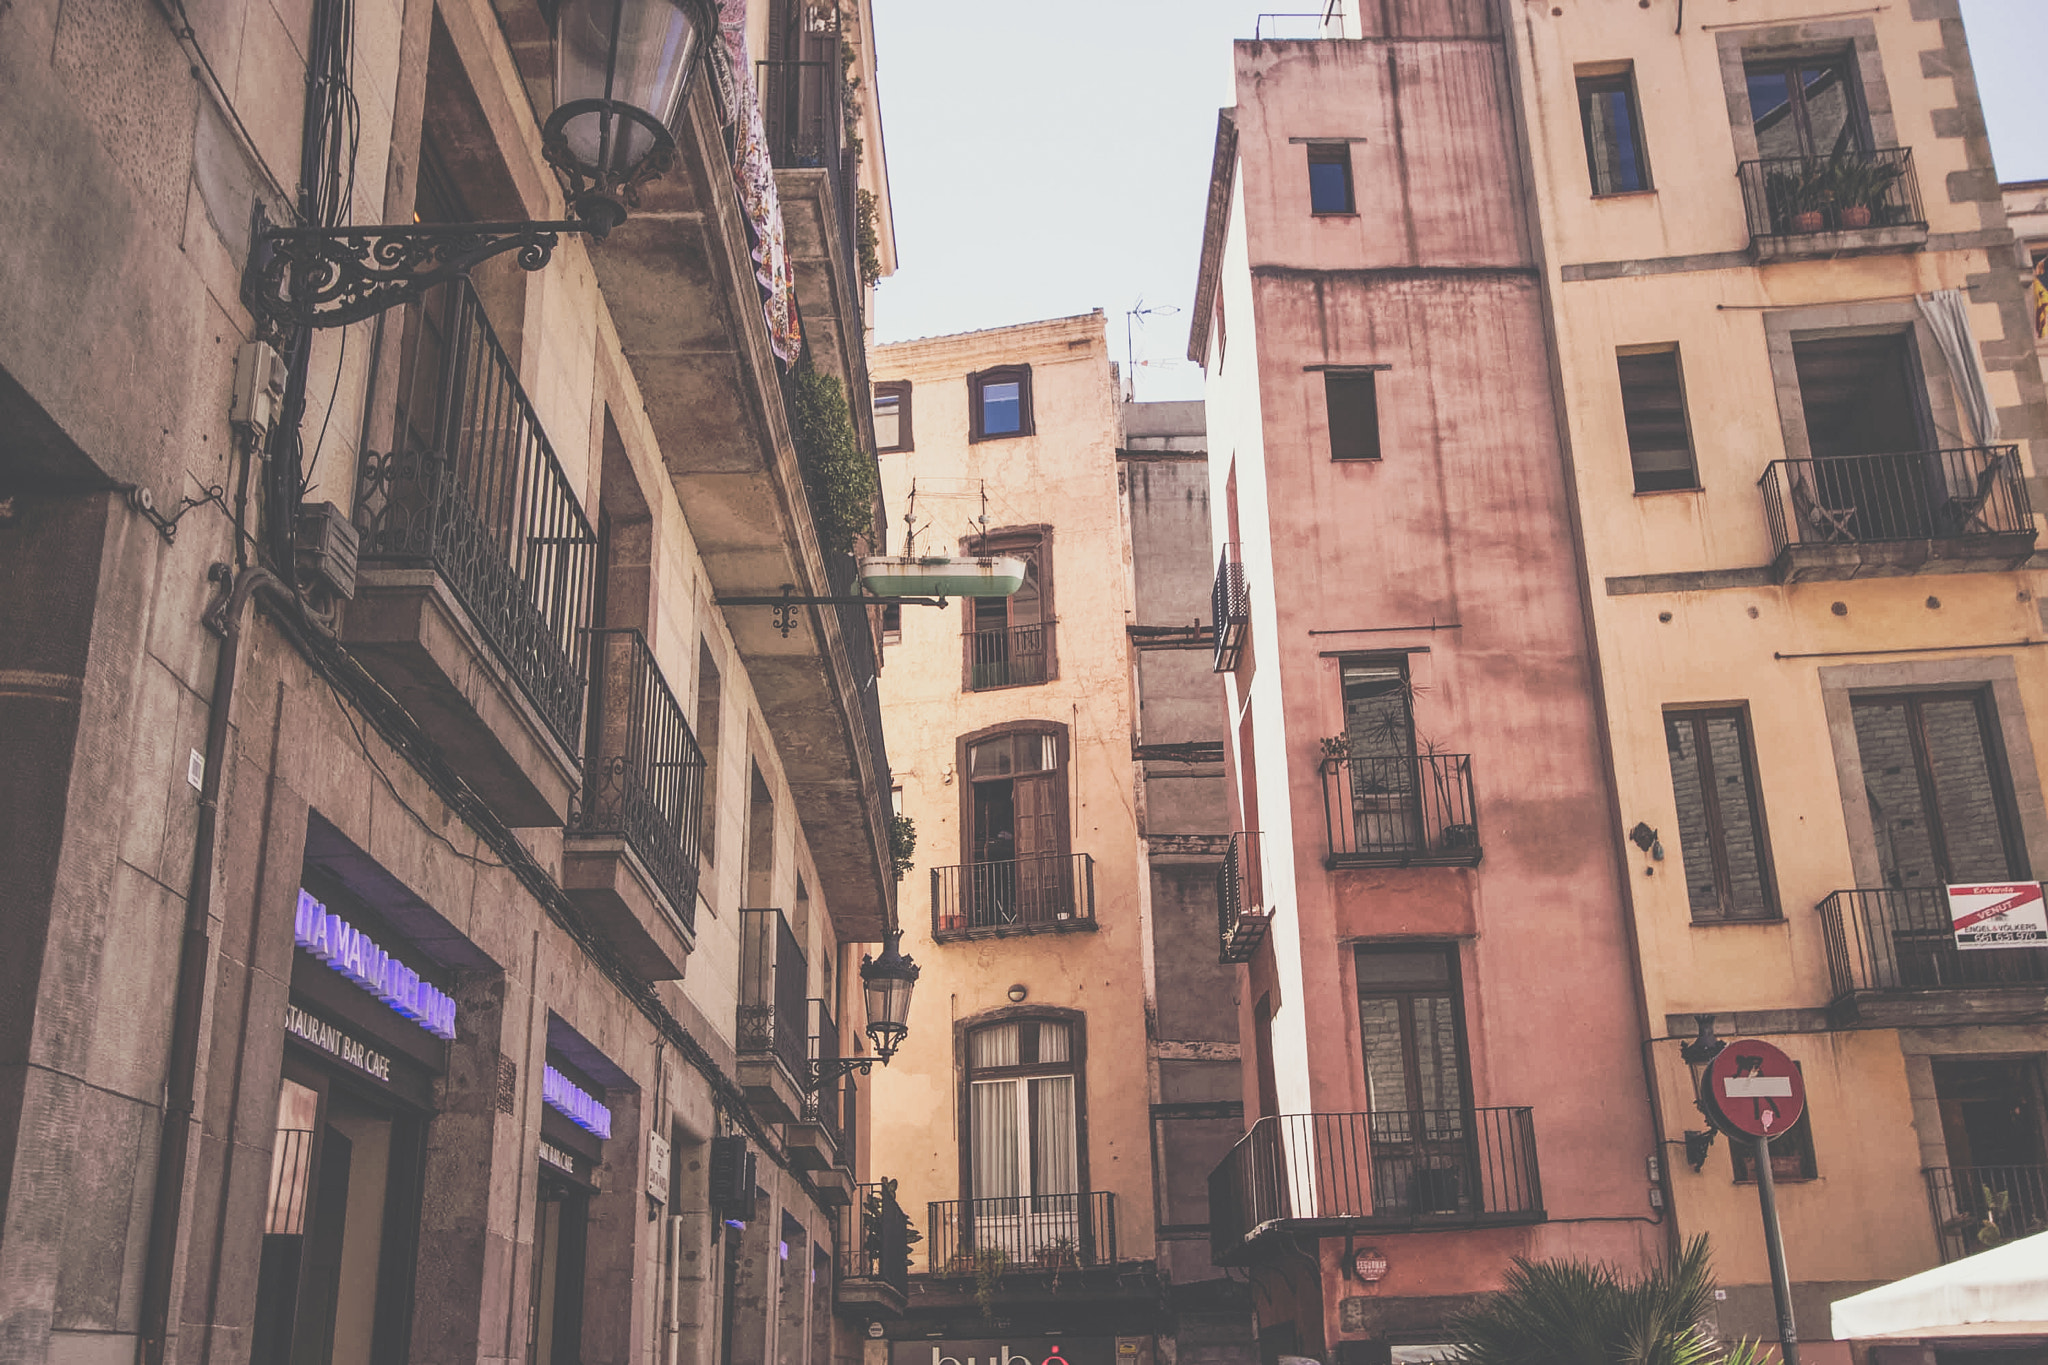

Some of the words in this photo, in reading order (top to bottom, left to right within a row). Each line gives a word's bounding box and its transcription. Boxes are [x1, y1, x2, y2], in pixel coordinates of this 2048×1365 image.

[1976, 901, 2012, 919] VENUT
[328, 914, 388, 997] MARIA
[342, 1033, 364, 1069] BAR
[365, 1050, 390, 1081] CAFE
